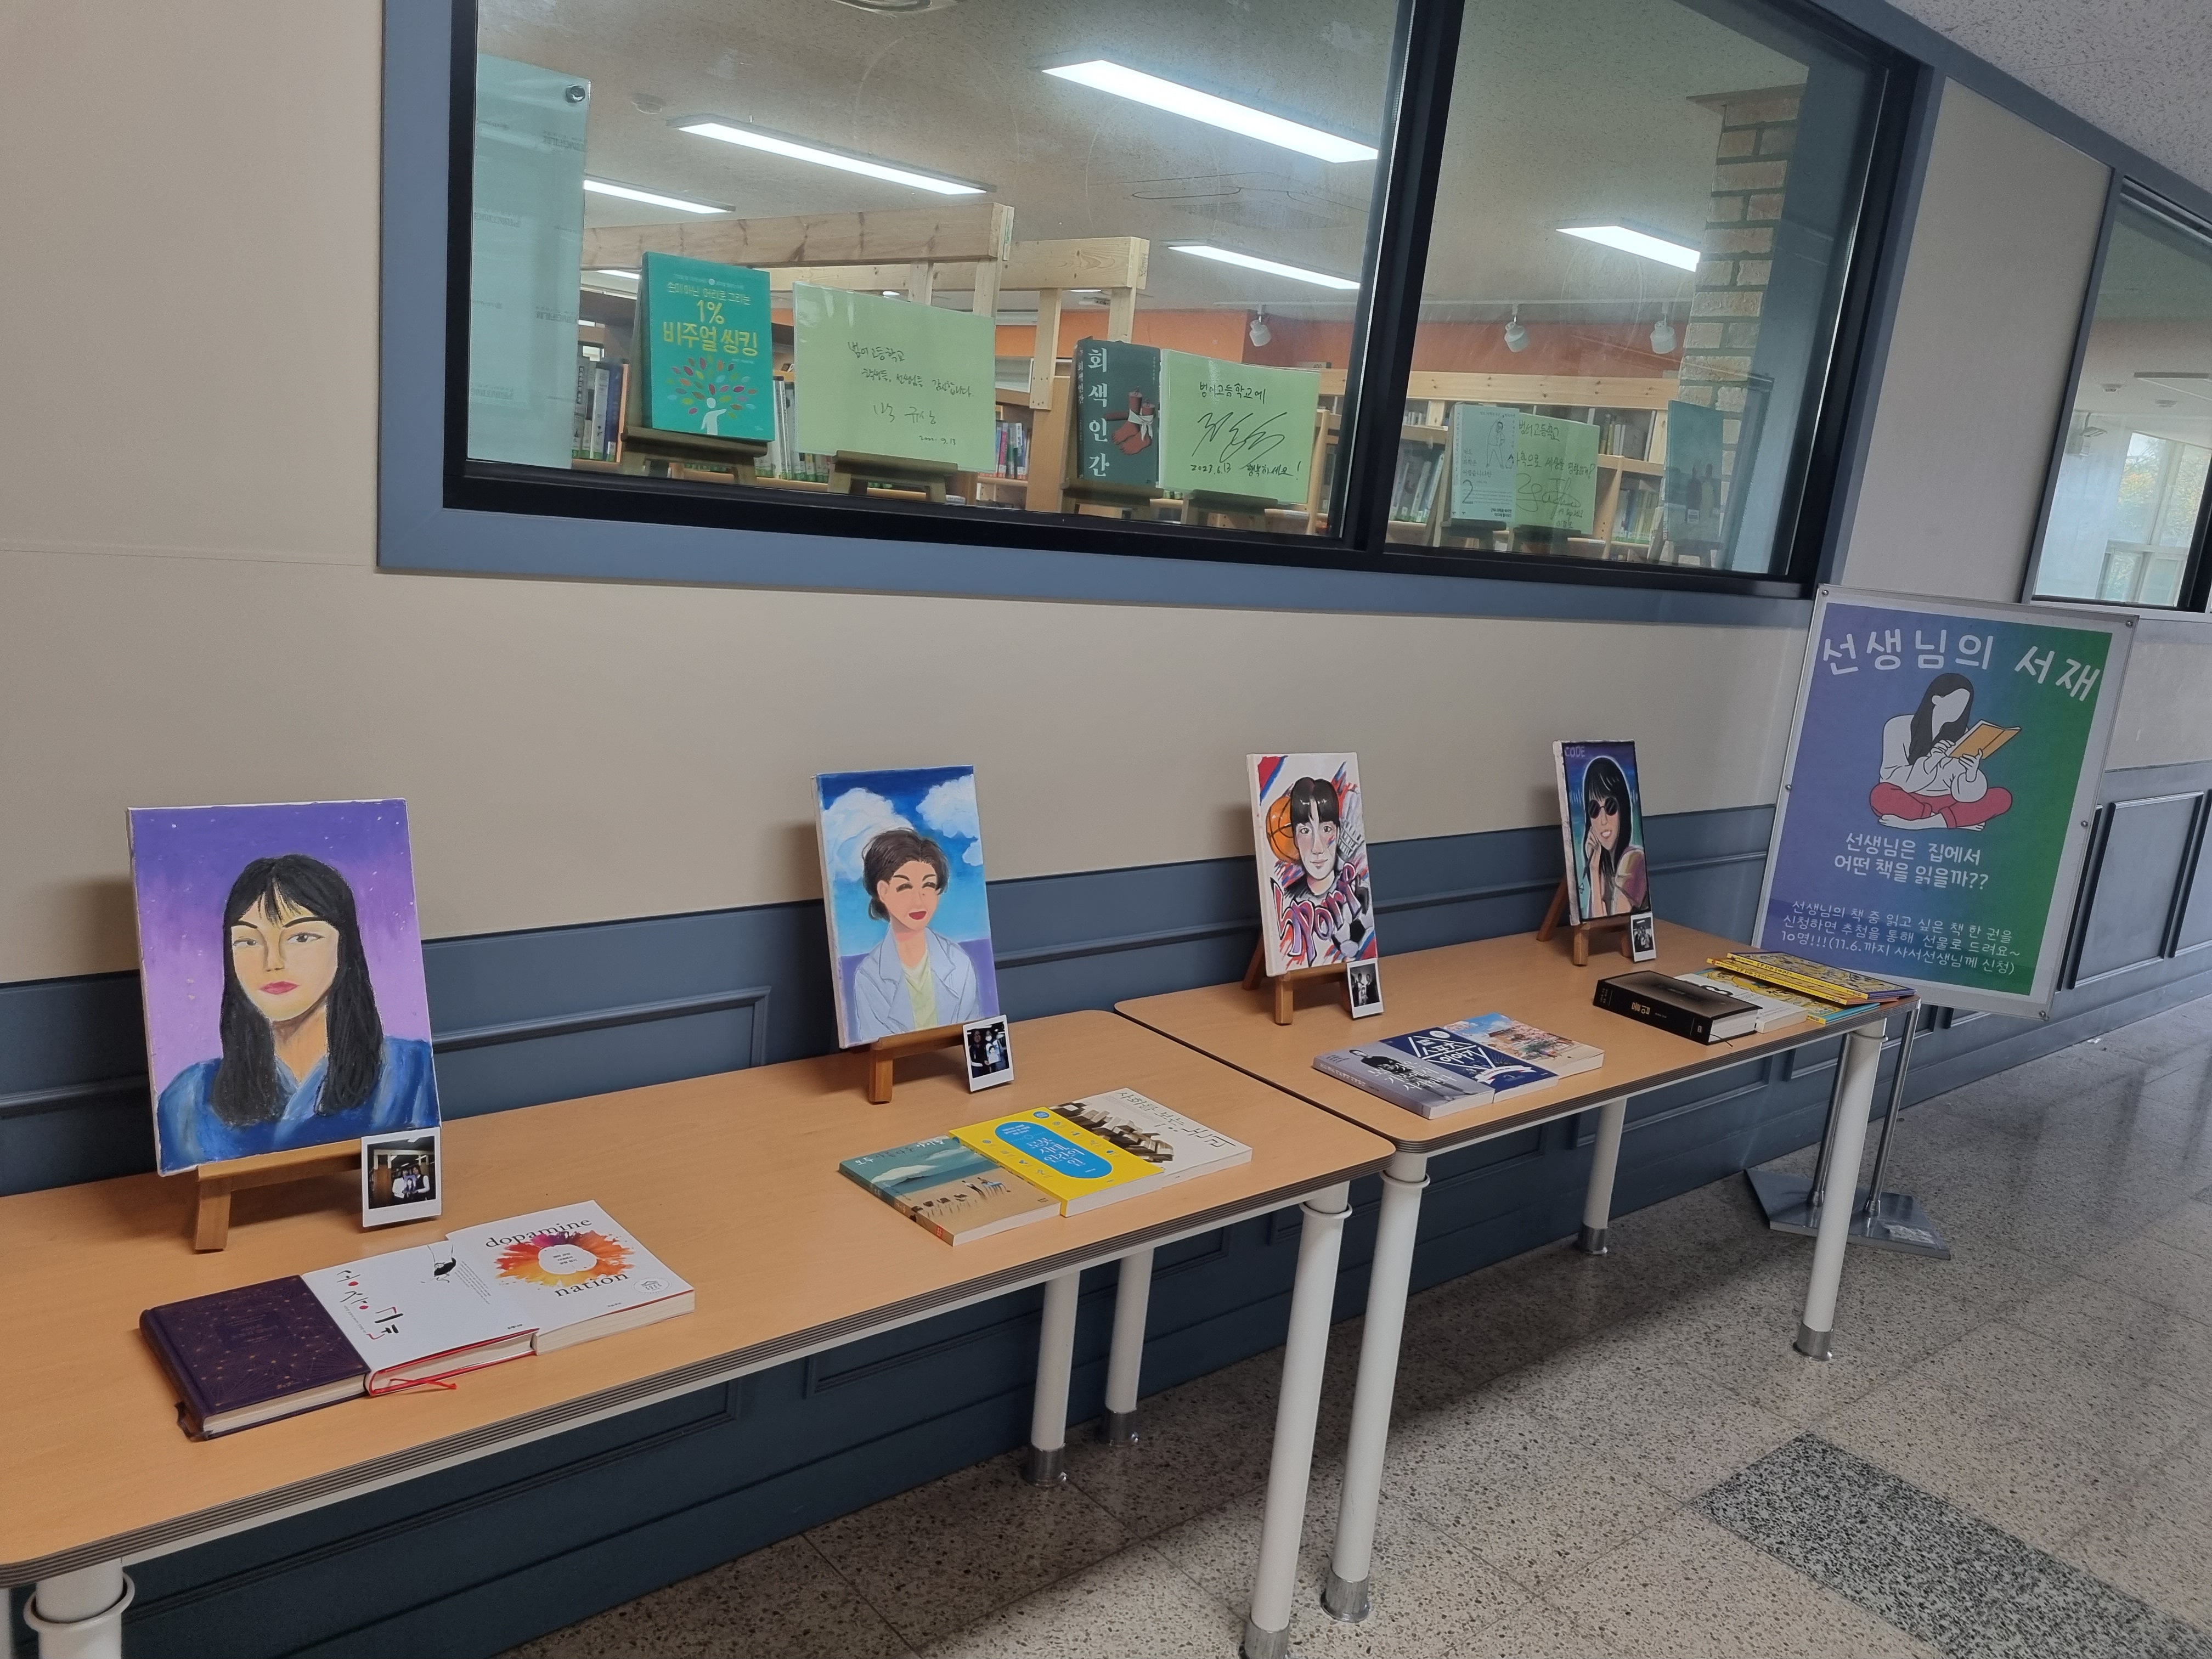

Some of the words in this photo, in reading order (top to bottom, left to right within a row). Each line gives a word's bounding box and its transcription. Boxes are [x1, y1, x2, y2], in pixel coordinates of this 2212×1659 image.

[697, 300, 725, 324] 1%
[663, 321, 718, 352] 비주얼
[720, 329, 758, 357] 씽킹
[1462, 479, 1474, 504] 2
[1822, 628, 1994, 675] 선생님의
[2014, 645, 2100, 702] 서재
[1564, 746, 1585, 758] CODE
[1846, 832, 1916, 860] 선생님은
[1928, 843, 1981, 866] 집에서
[1834, 855, 1870, 876] 어떤
[1875, 859, 1909, 883] 책을
[1915, 865, 1989, 890] 읽을까??
[1783, 915, 1837, 934] 신청하면
[1841, 923, 1880, 941] 추첨을
[1886, 929, 1914, 944] 통해
[1922, 935, 1962, 951] 선물로
[1968, 941, 2021, 957] 드려요~
[1792, 900, 1846, 918] 선생님의
[1850, 908, 1864, 922] 책
[1868, 911, 1880, 924] 중
[1886, 914, 1912, 928] 읽고
[1918, 918, 1943, 934] 싶은
[1950, 922, 1964, 936] 책
[1969, 924, 1982, 939] 한
[1986, 927, 2012, 944] 권을
[1894, 946, 1978, 969] 사서선생님께
[1982, 959, 2015, 975] 신청)
[1421, 1042, 1477, 1060] 스포츠
[1438, 1048, 1487, 1065] 이야기
[1116, 1092, 1159, 1111] 사회를
[1154, 1111, 1184, 1126] 보는
[1181, 1127, 1237, 1148] 논리
[855, 1156, 874, 1166] 모두
[1043, 1148, 1086, 1163] 인간의
[485, 1218, 592, 1249] dopamine
[554, 1272, 630, 1297] nation
